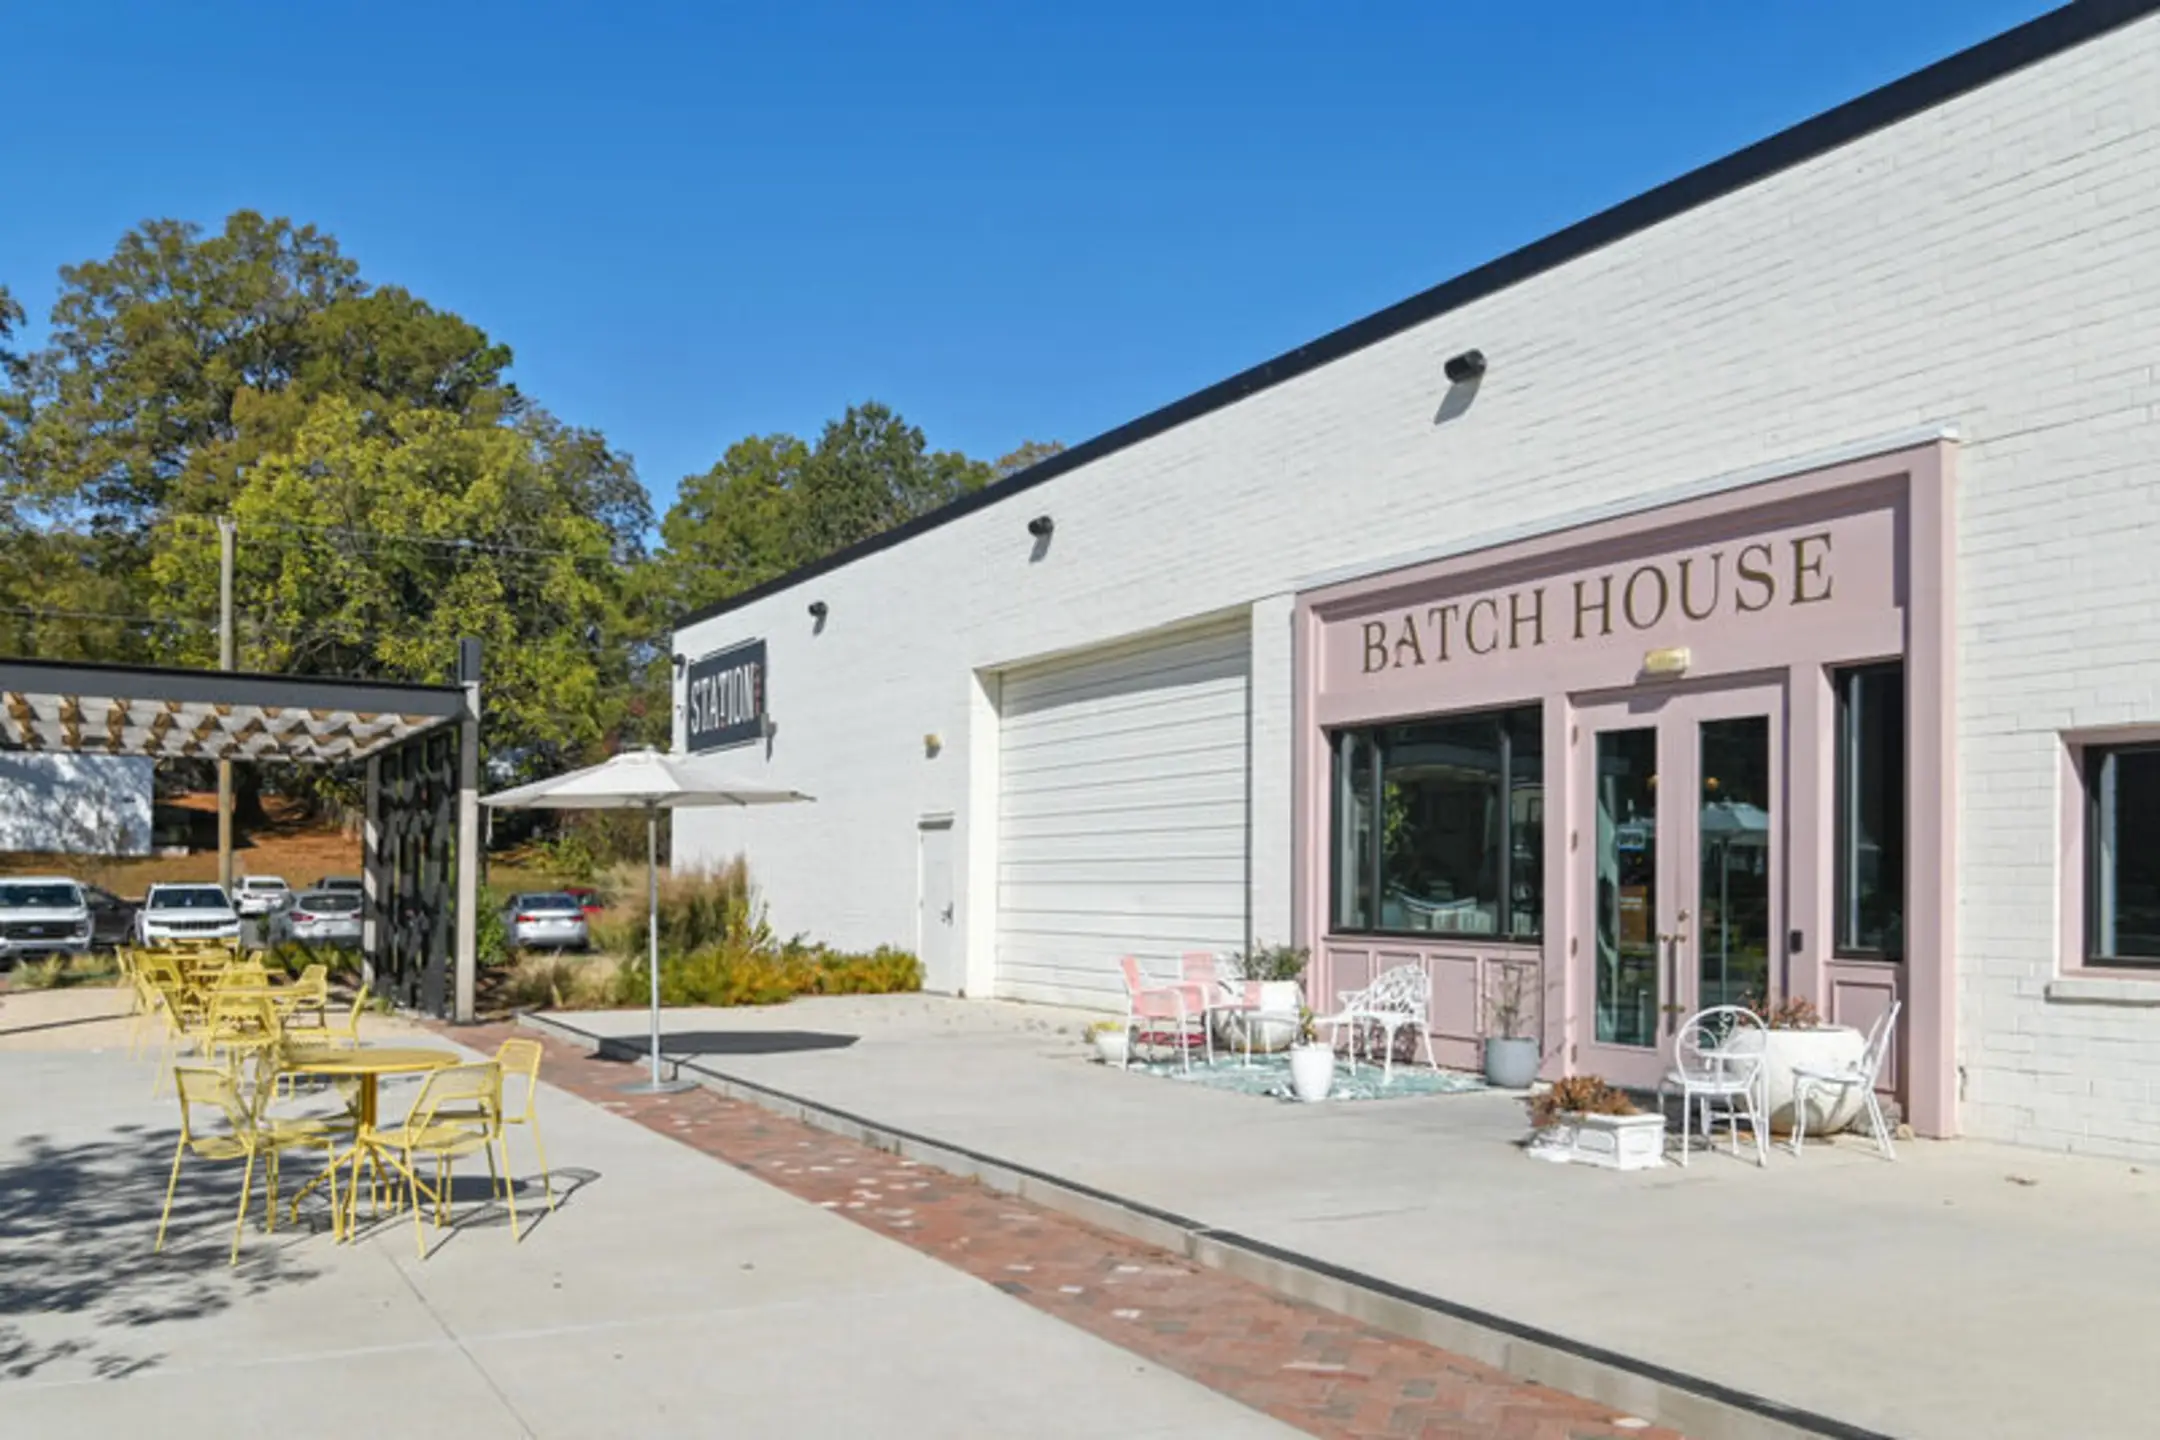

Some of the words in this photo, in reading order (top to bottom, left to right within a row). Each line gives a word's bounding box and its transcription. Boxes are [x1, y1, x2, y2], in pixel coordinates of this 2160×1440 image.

[1362, 588, 1545, 673] BATCH
[1572, 532, 1833, 640] HOUSE
[691, 662, 754, 734] STATION
